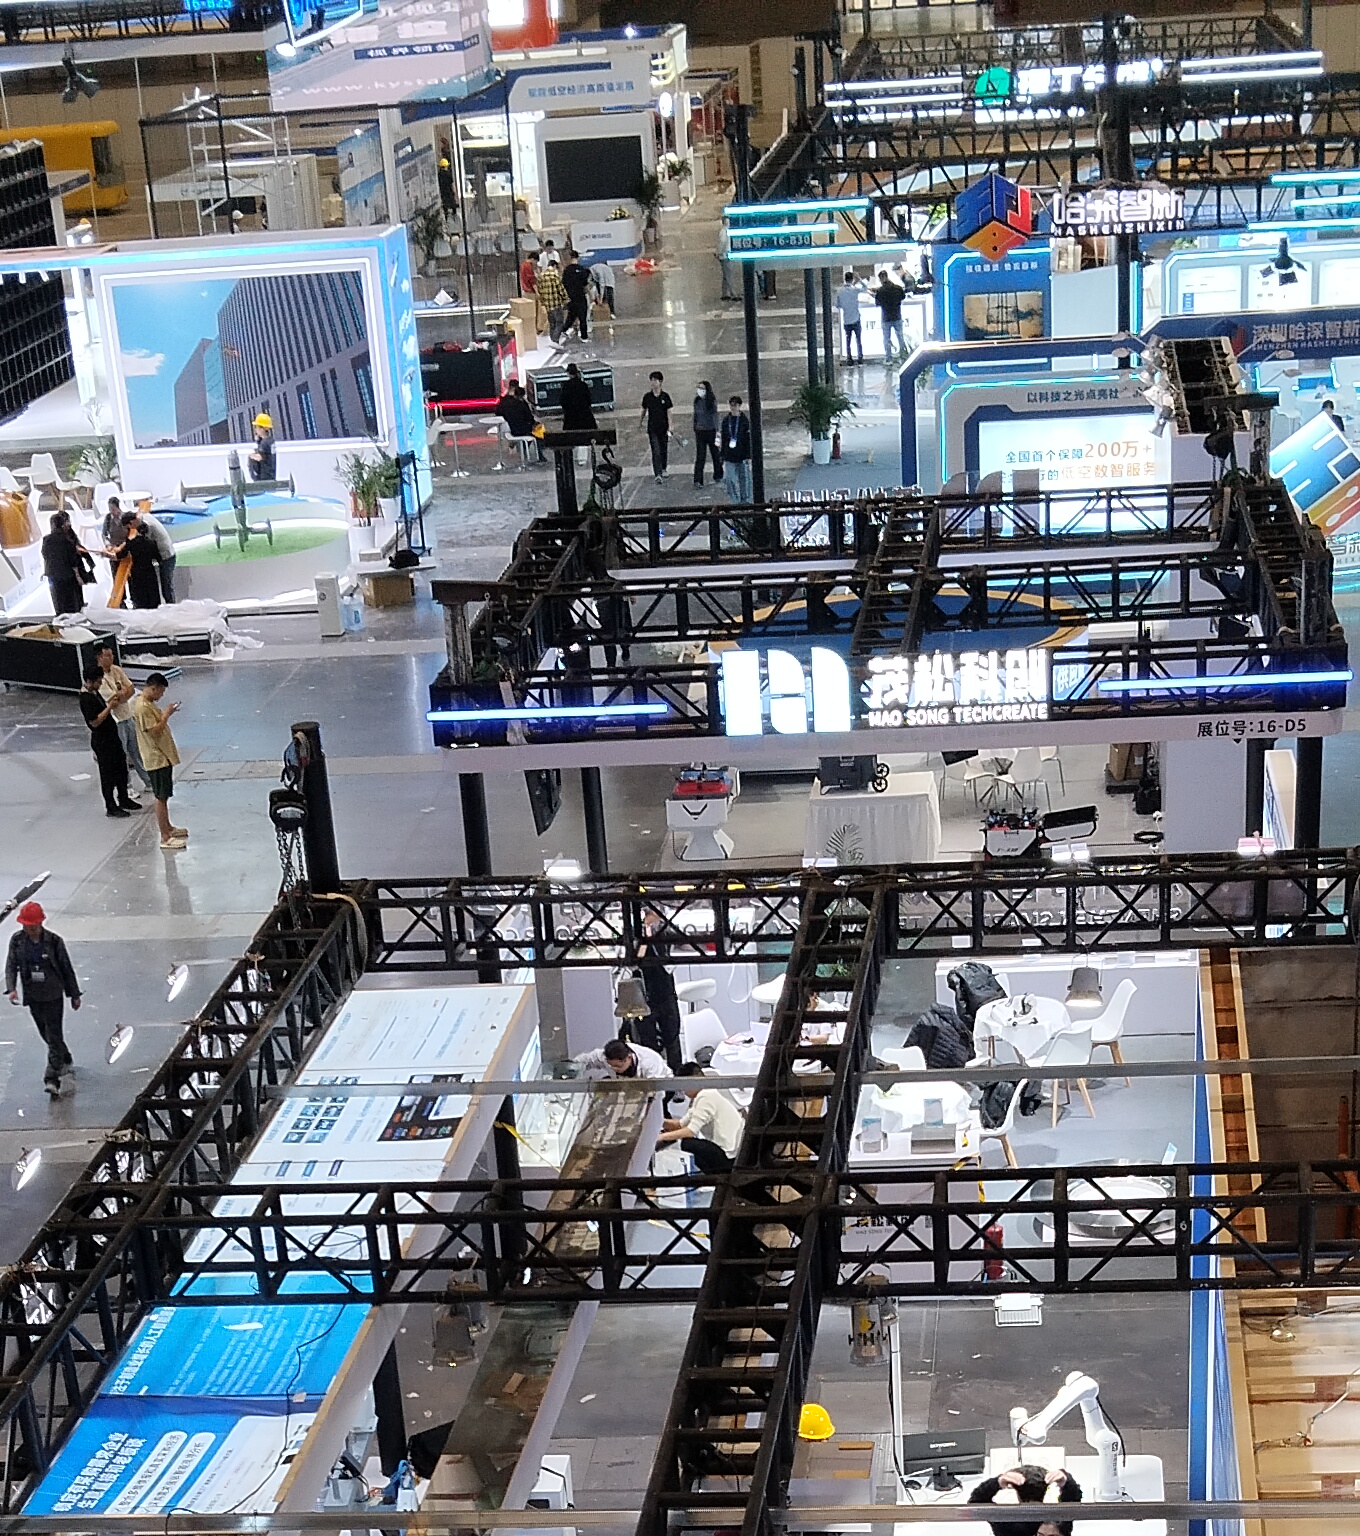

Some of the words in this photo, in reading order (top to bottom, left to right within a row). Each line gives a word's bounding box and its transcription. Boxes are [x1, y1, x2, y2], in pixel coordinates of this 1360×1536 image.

[1052, 188, 1184, 226] 哈深智新
[867, 647, 1048, 708] 茂松科创
[907, 709, 949, 726] SONG
[953, 703, 1048, 723] TECHCREATE
